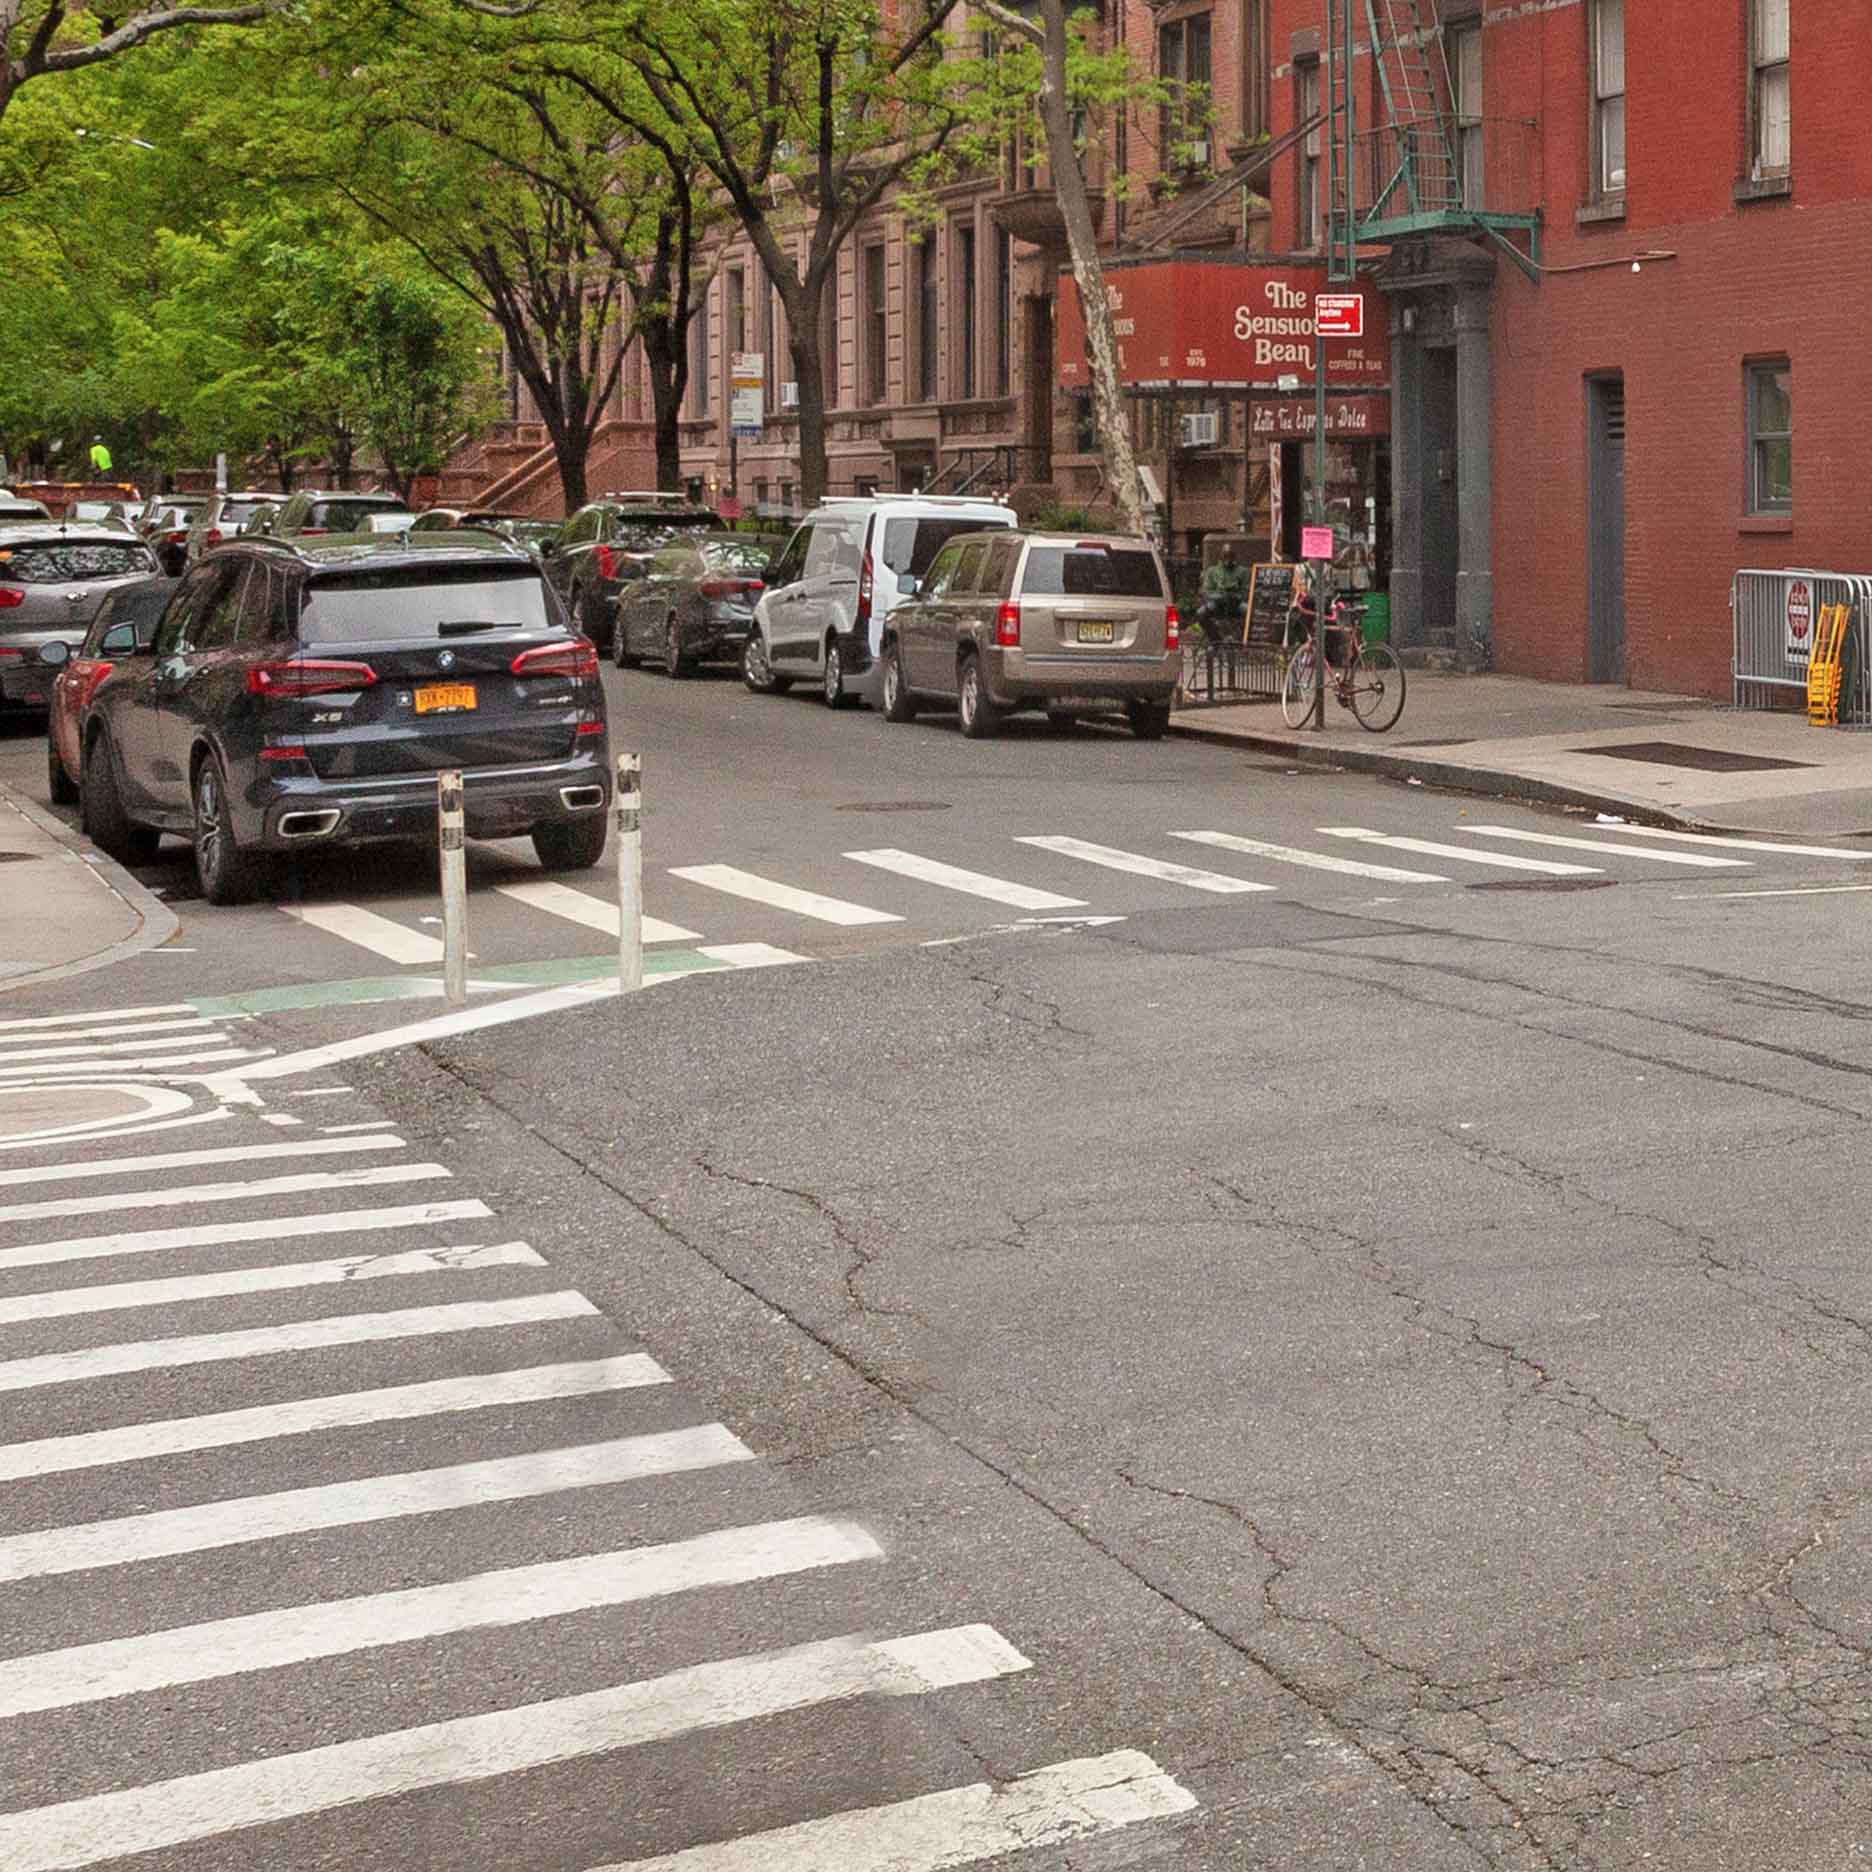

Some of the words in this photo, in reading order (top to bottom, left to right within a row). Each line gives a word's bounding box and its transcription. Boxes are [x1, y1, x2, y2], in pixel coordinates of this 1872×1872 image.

[1265, 281, 1307, 309] The
[1234, 305, 1316, 341] Sensuo
[1255, 339, 1317, 370] Bean
